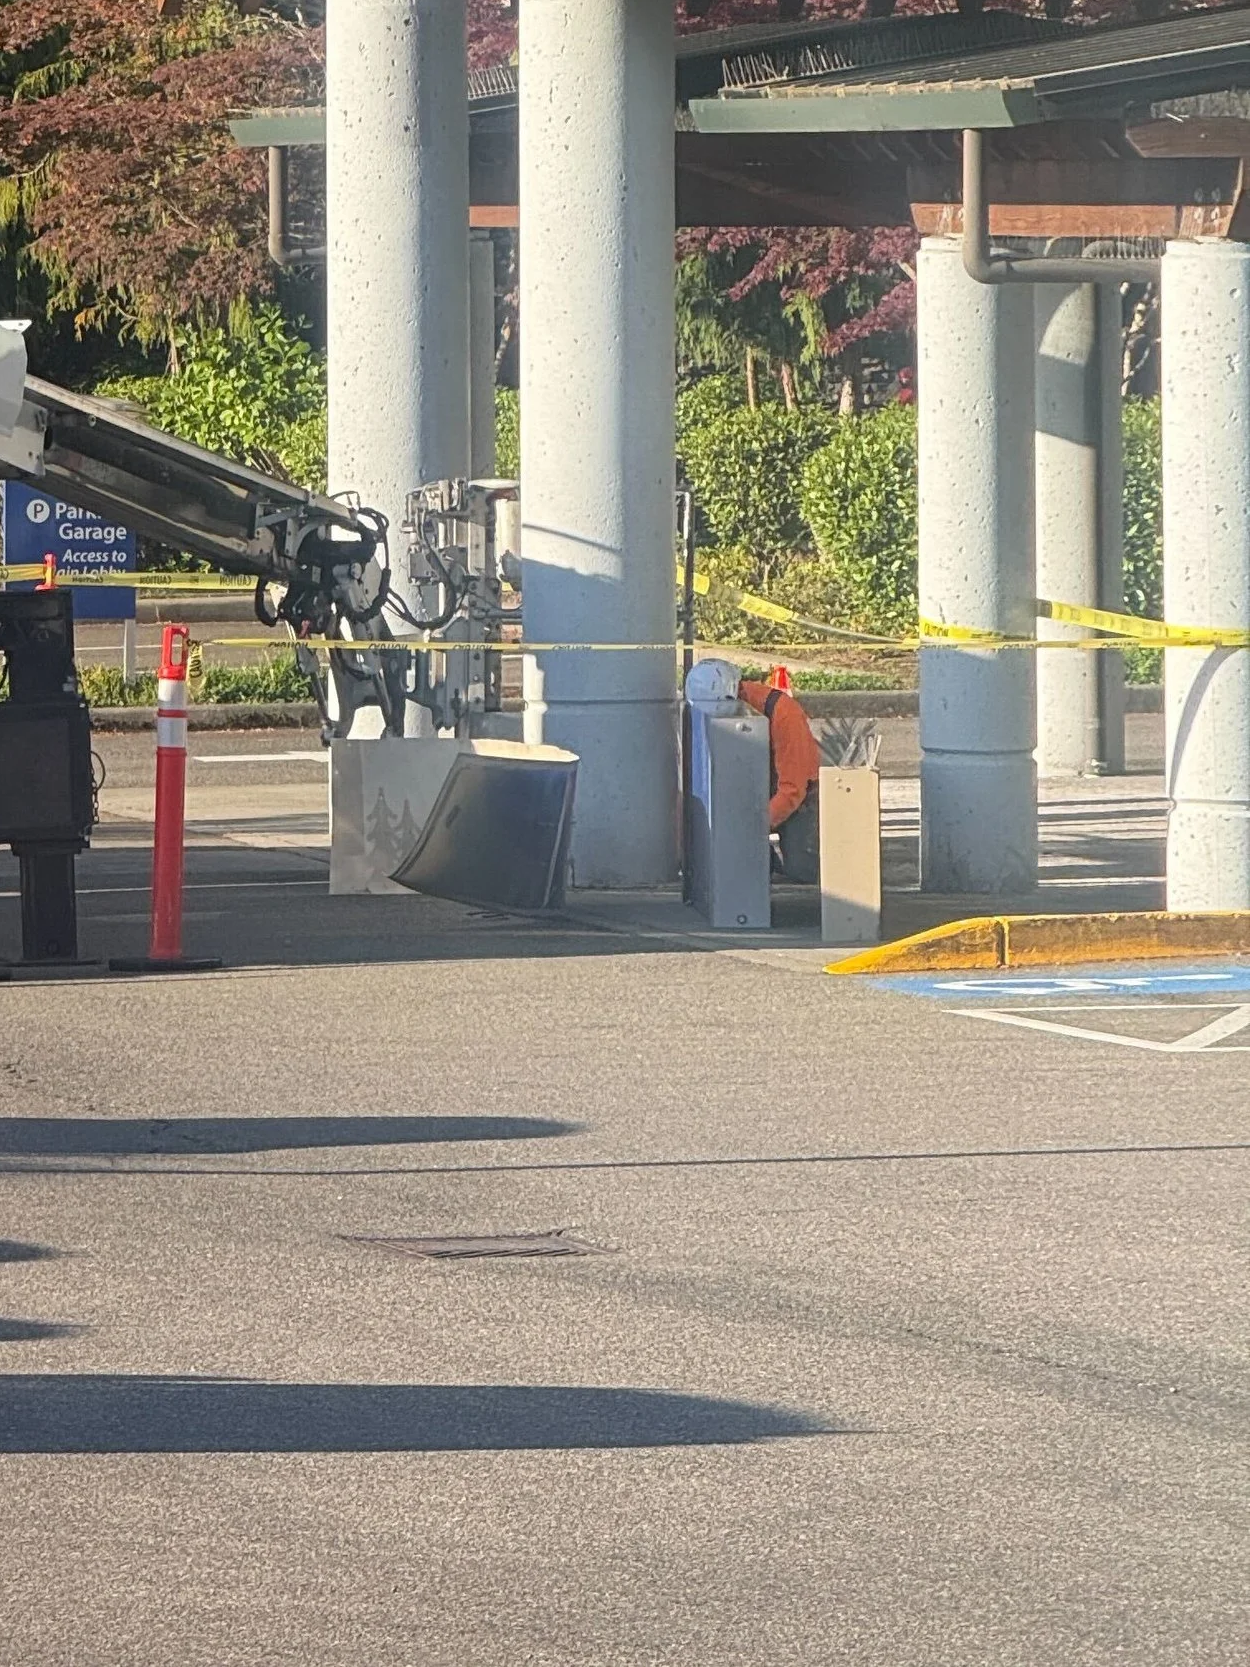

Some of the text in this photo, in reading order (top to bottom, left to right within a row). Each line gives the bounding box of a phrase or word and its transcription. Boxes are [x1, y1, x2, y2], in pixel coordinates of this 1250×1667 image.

[58, 522, 127, 544] Garage
[62, 548, 127, 563] Access to
